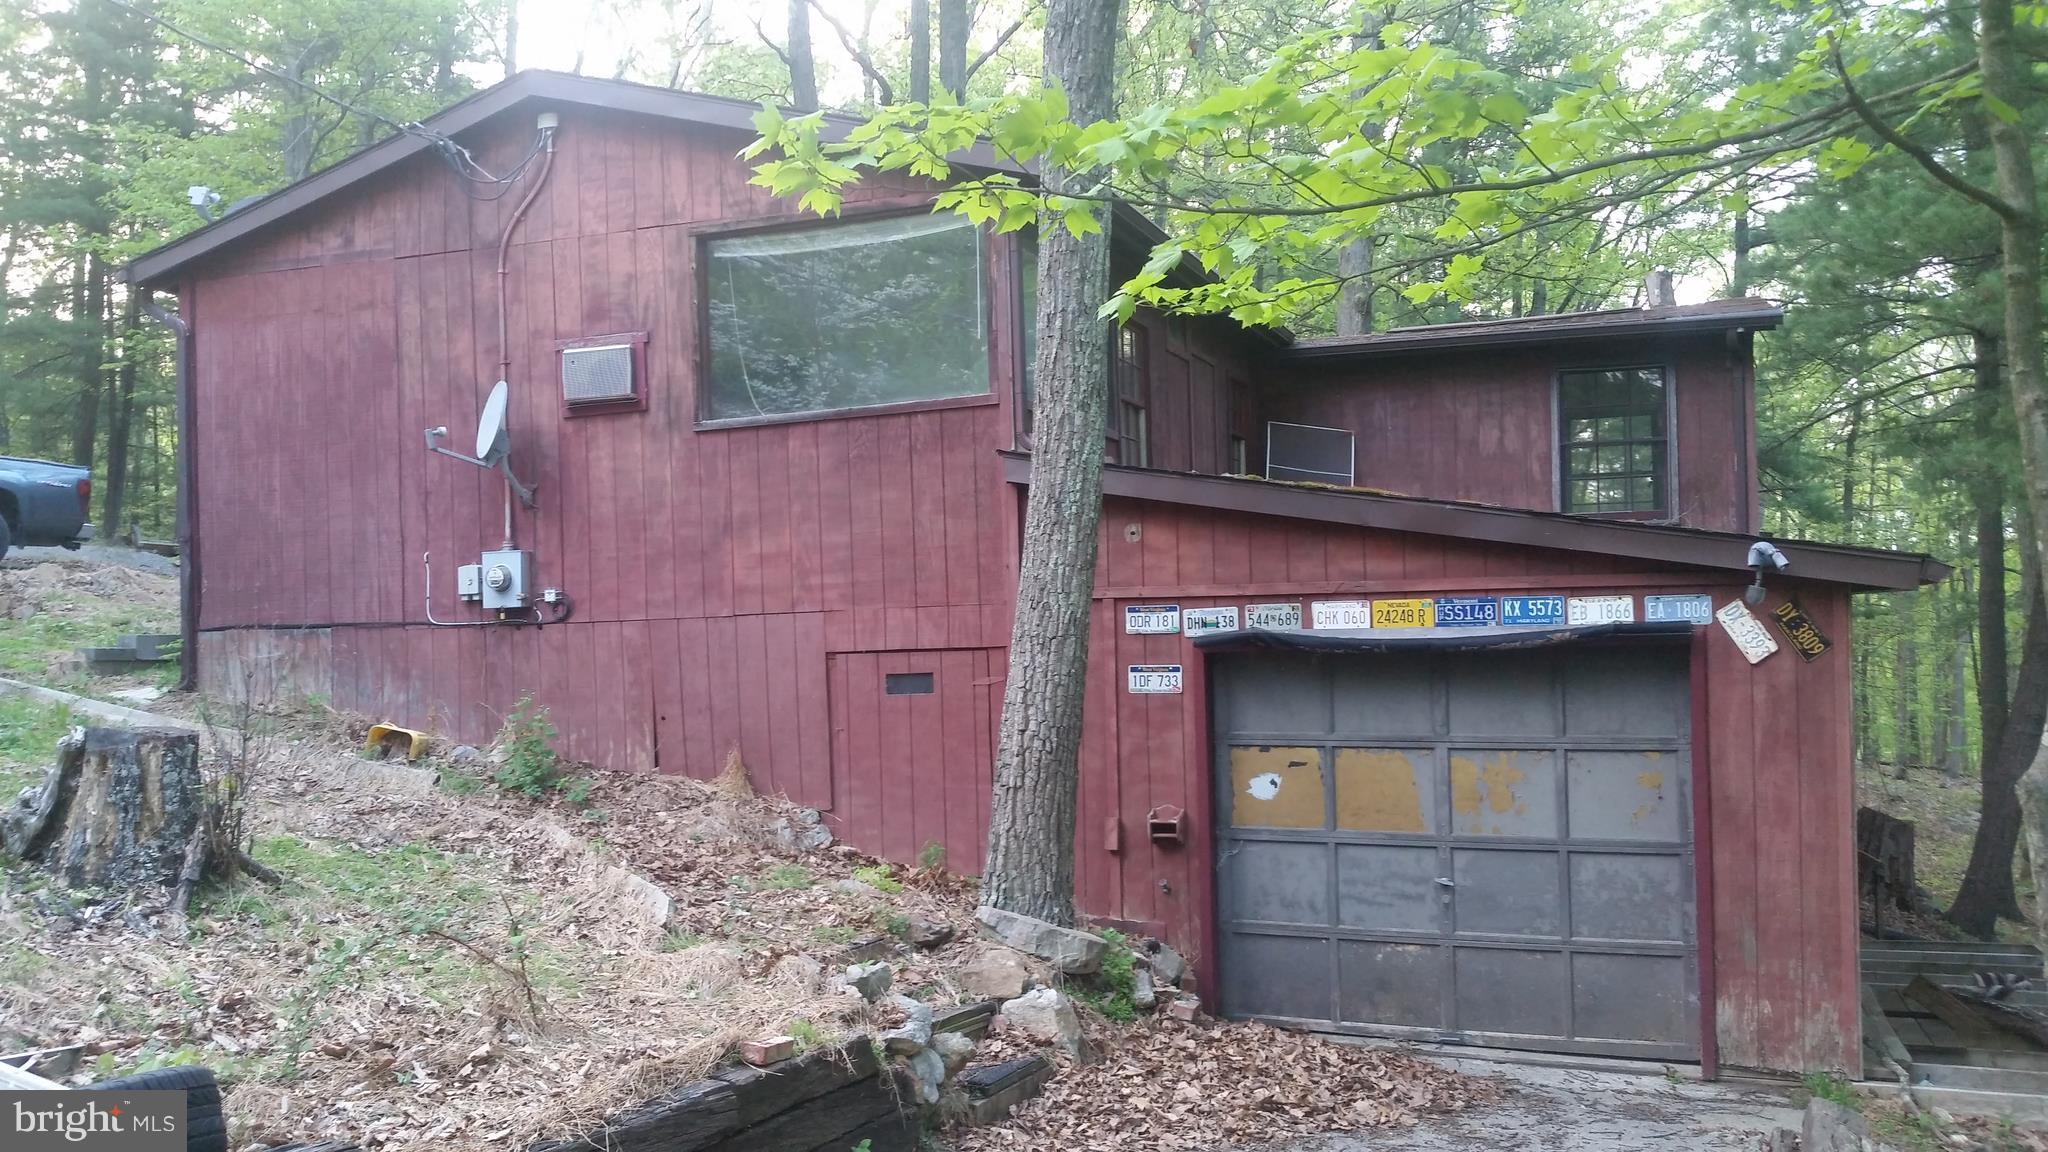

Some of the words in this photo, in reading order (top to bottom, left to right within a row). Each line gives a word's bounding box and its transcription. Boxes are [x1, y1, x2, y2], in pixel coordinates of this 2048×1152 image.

[1376, 608, 1414, 624] 24248
[1418, 608, 1426, 623] R
[1444, 604, 1494, 620] SS148
[1504, 600, 1521, 617] KX
[1528, 599, 1563, 616] 5573
[1570, 604, 1588, 621] EB
[1598, 603, 1632, 620] 1866
[1155, 614, 1175, 628] 181
[1248, 613, 1270, 627] 544
[1277, 611, 1300, 627] 689
[1317, 611, 1339, 625] CHK
[1343, 610, 1366, 625] 060
[1776, 602, 1799, 622] DY
[1793, 623, 1826, 655] 3809
[1133, 674, 1153, 688] 1DF
[1157, 674, 1179, 688] 733
